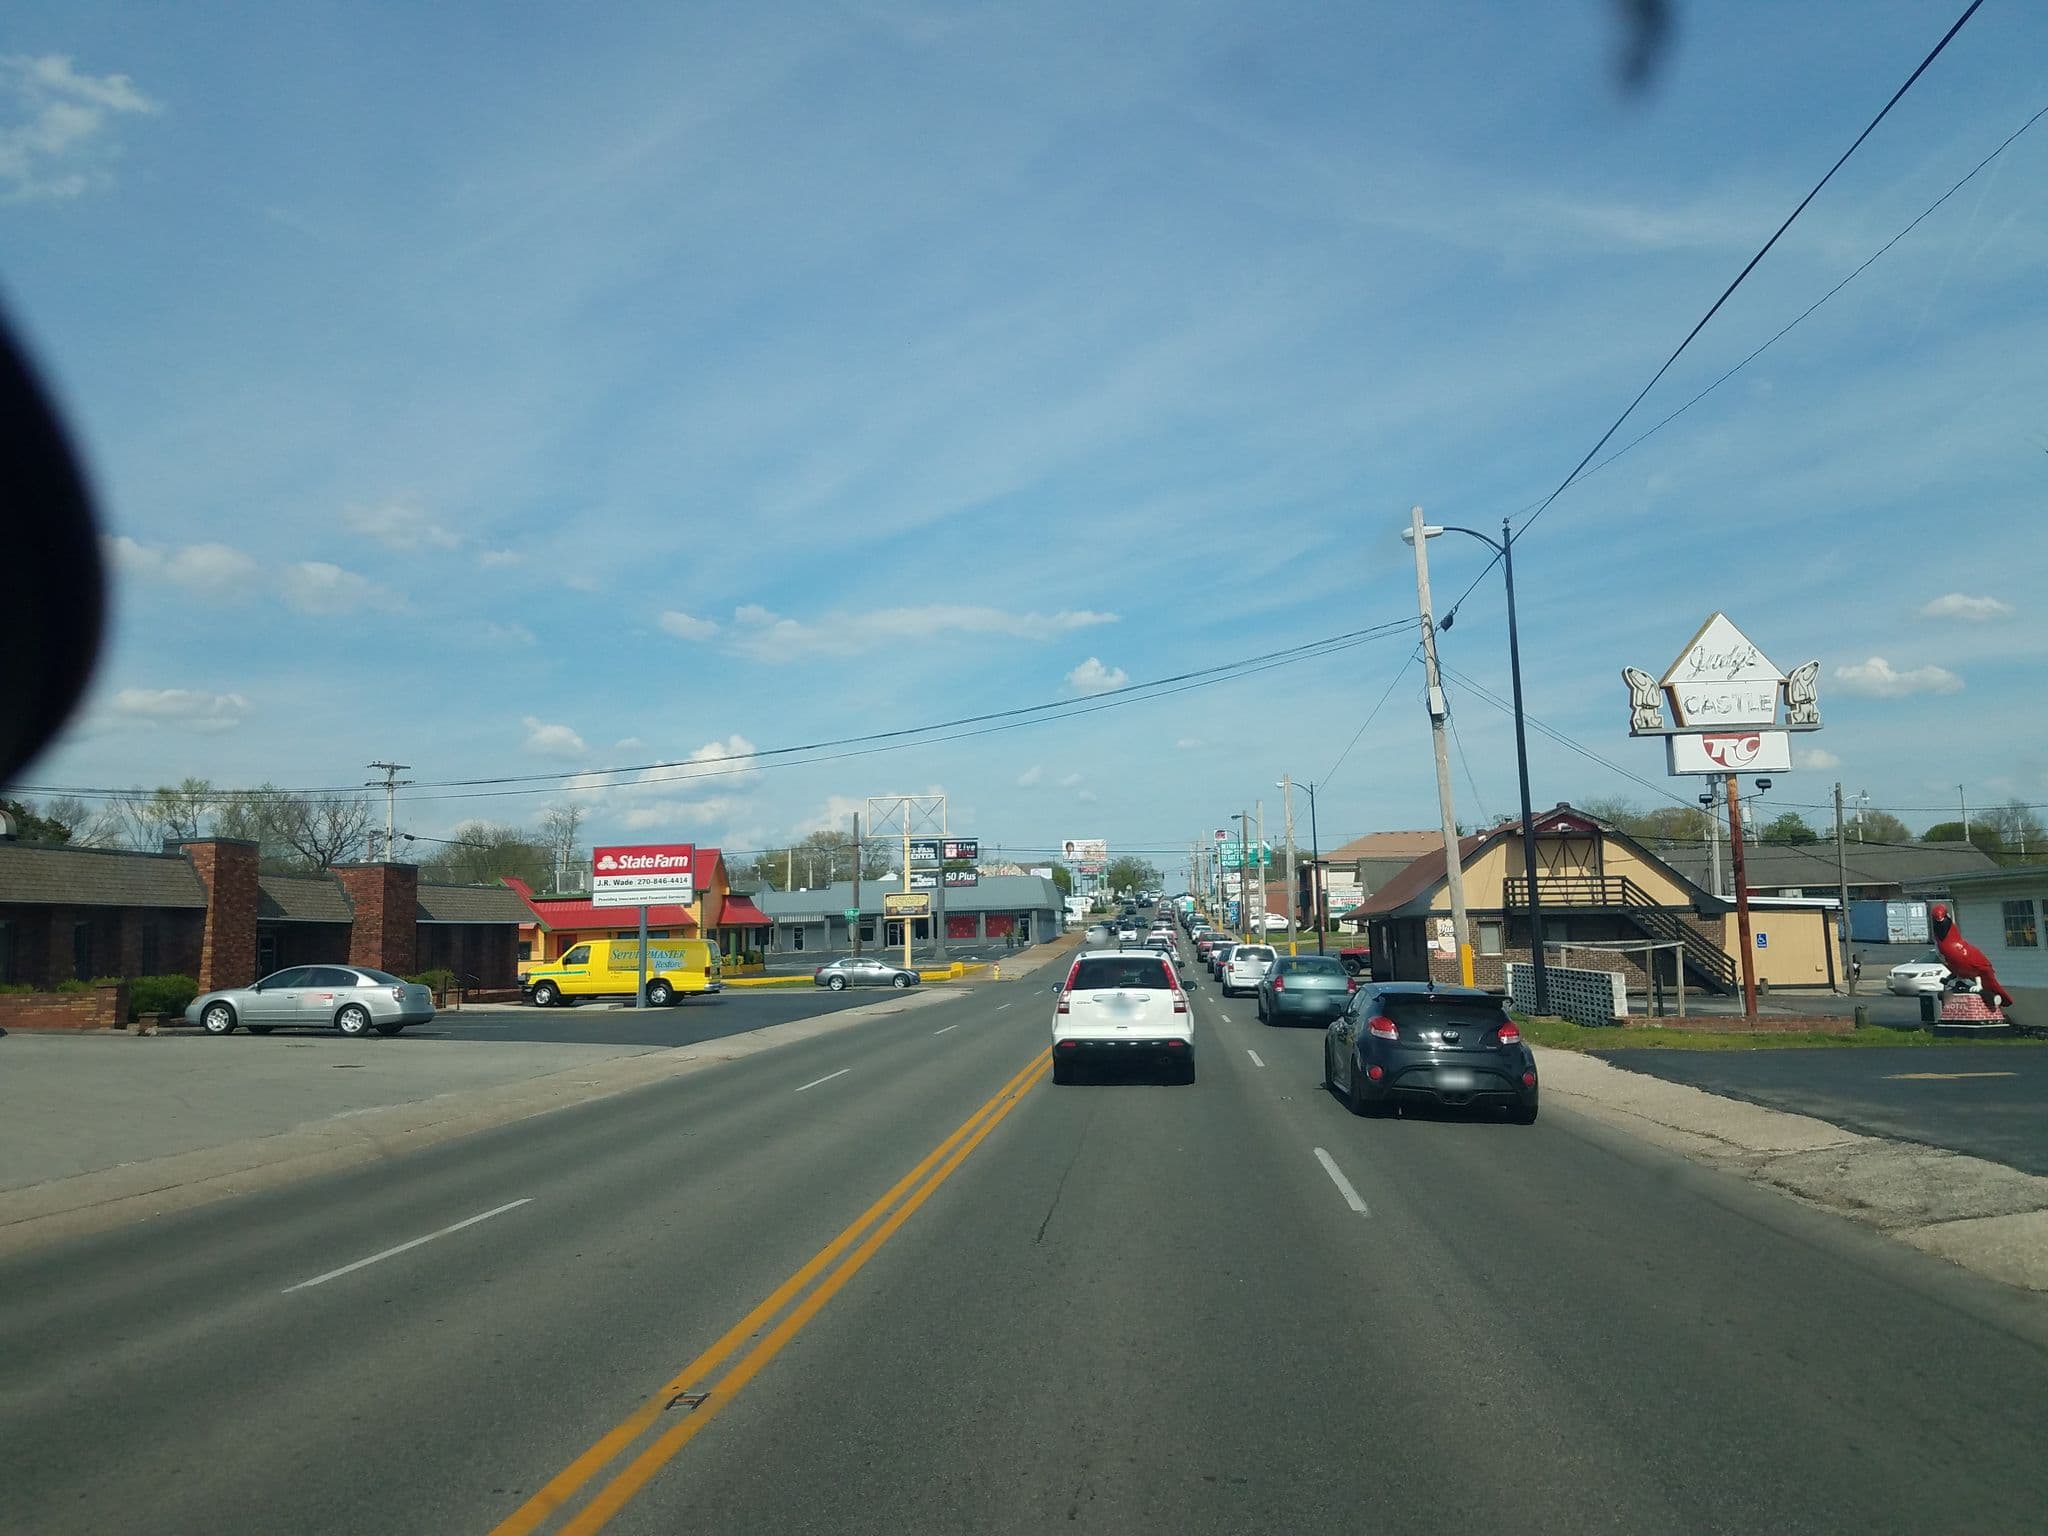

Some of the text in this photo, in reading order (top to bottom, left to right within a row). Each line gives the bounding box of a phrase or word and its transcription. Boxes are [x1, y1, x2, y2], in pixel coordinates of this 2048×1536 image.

[1683, 694, 1773, 715] CASTLE
[1704, 737, 1760, 768] RC
[637, 877, 688, 885] 270-846-4414
[945, 872, 977, 881] 50 Plus
[655, 960, 682, 969] Restore
